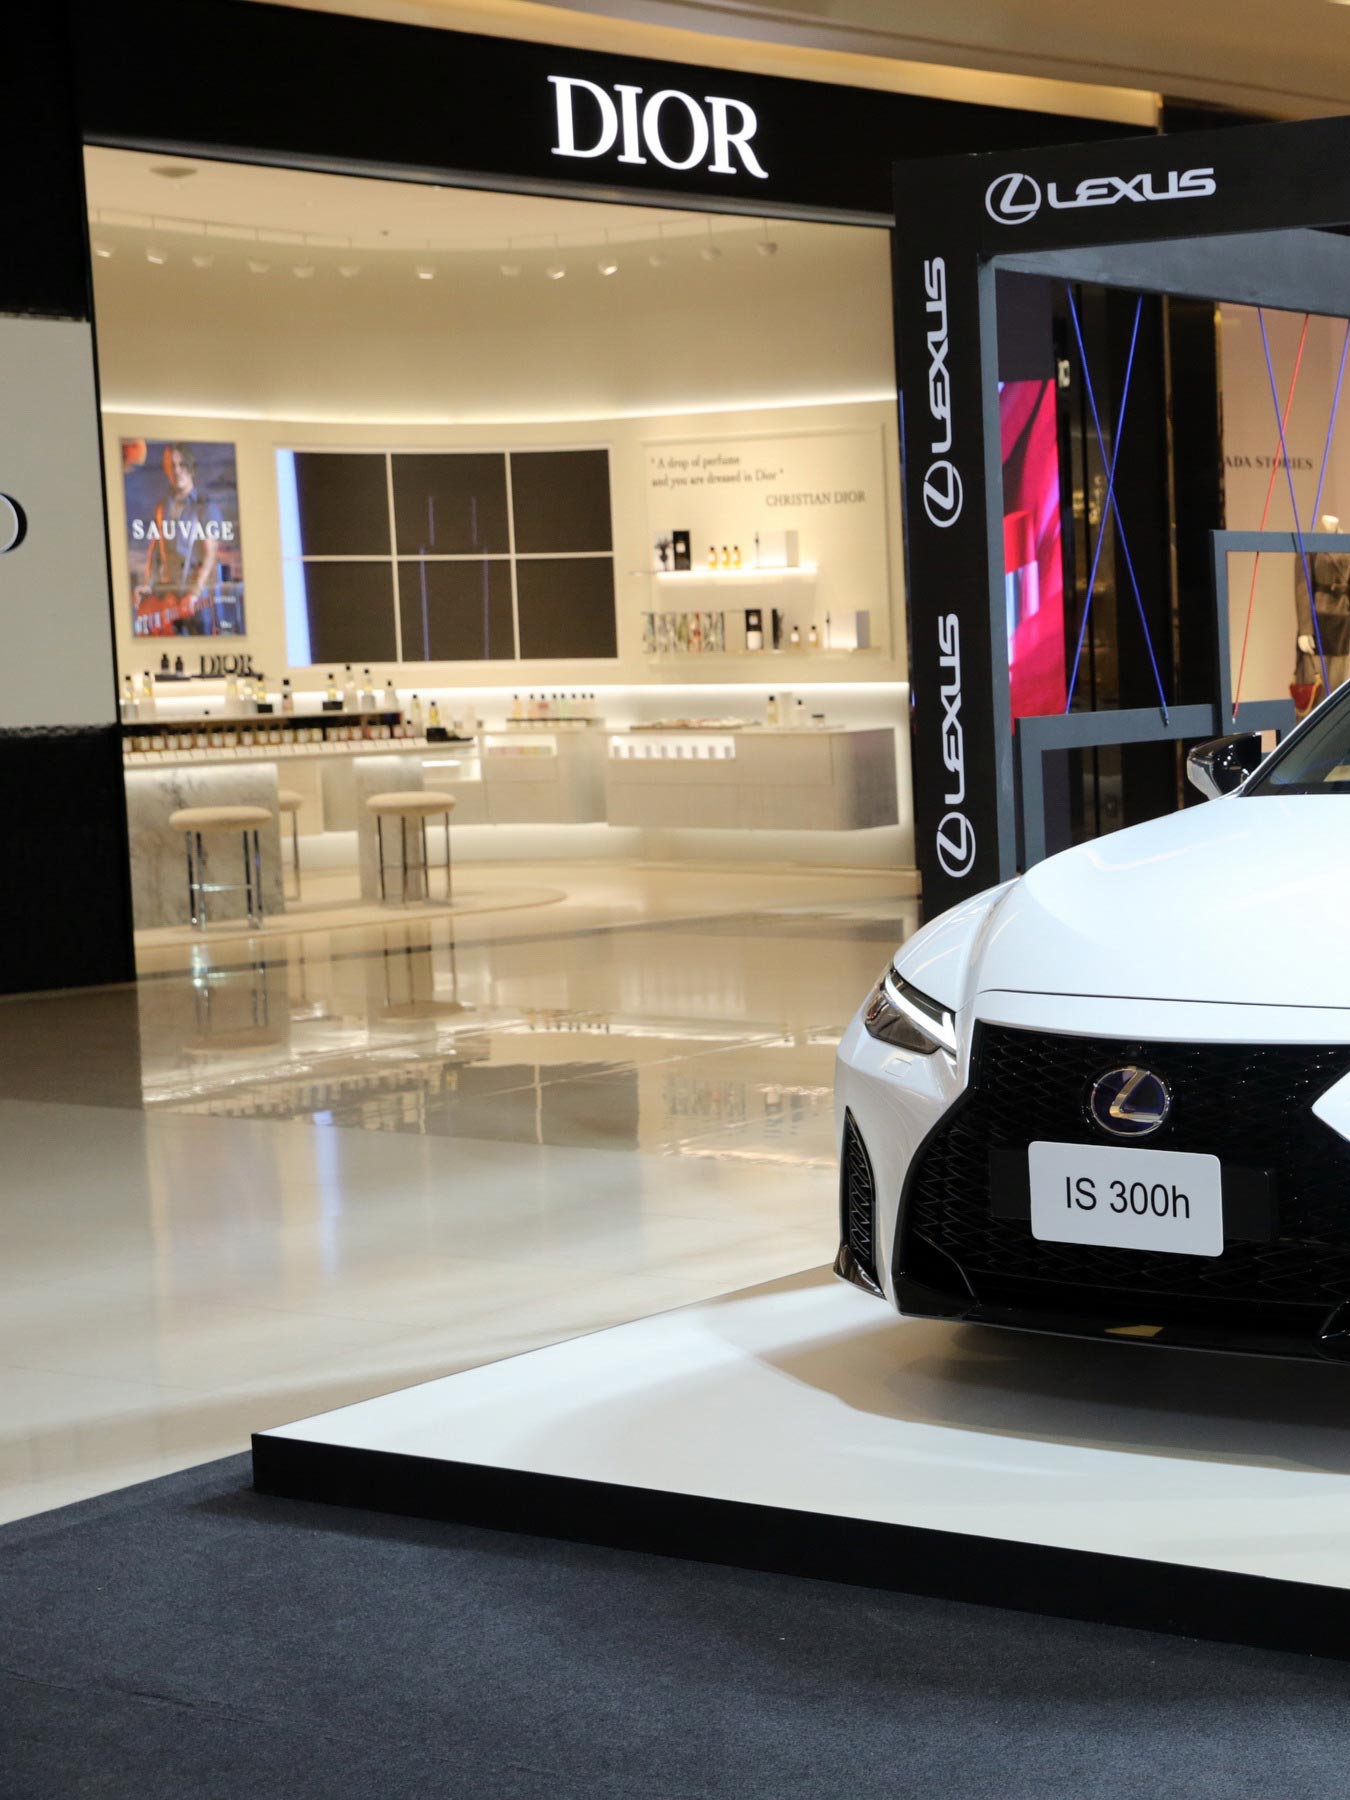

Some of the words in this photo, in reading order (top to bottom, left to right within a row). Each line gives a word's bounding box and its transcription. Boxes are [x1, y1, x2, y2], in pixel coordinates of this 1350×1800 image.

[547, 75, 769, 179] DIOR
[1047, 167, 1216, 209] LEXUS
[923, 256, 952, 454] LEXUS
[667, 456, 689, 471] drop
[691, 454, 701, 467] of
[703, 453, 741, 470] perfume
[1255, 456, 1313, 470] STORIES
[652, 473, 669, 487] and
[670, 478, 688, 490] you
[690, 476, 704, 485] are
[707, 470, 741, 484] dressed
[743, 473, 753, 482] in
[766, 492, 831, 507] CHRISTIAN
[834, 490, 866, 504] DIOR
[132, 519, 235, 542] SAUVAGE
[200, 654, 254, 676] DIOR
[938, 613, 966, 805] LEXUS
[1066, 1176, 1097, 1211] IS
[1110, 1180, 1190, 1219] 300h
